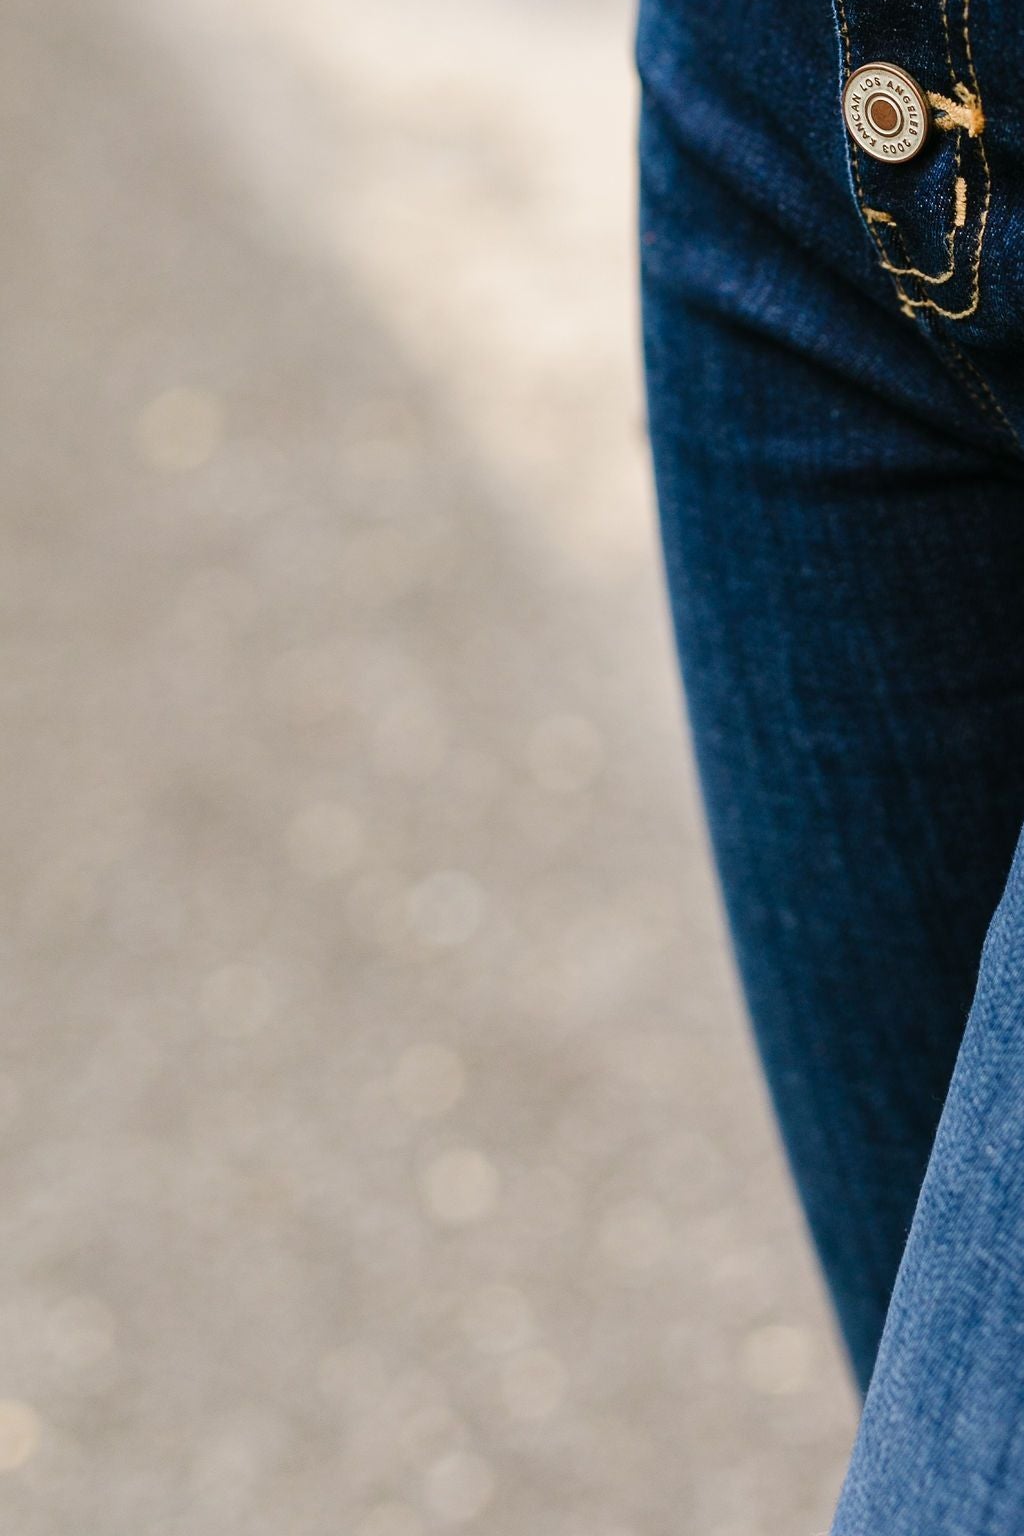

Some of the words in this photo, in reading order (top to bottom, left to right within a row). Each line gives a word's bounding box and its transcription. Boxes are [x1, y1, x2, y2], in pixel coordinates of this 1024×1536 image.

[859, 77, 881, 92] LOS
[851, 93, 877, 147] KANCAN
[886, 81, 919, 136] ANGELES
[882, 138, 911, 154] 2003
